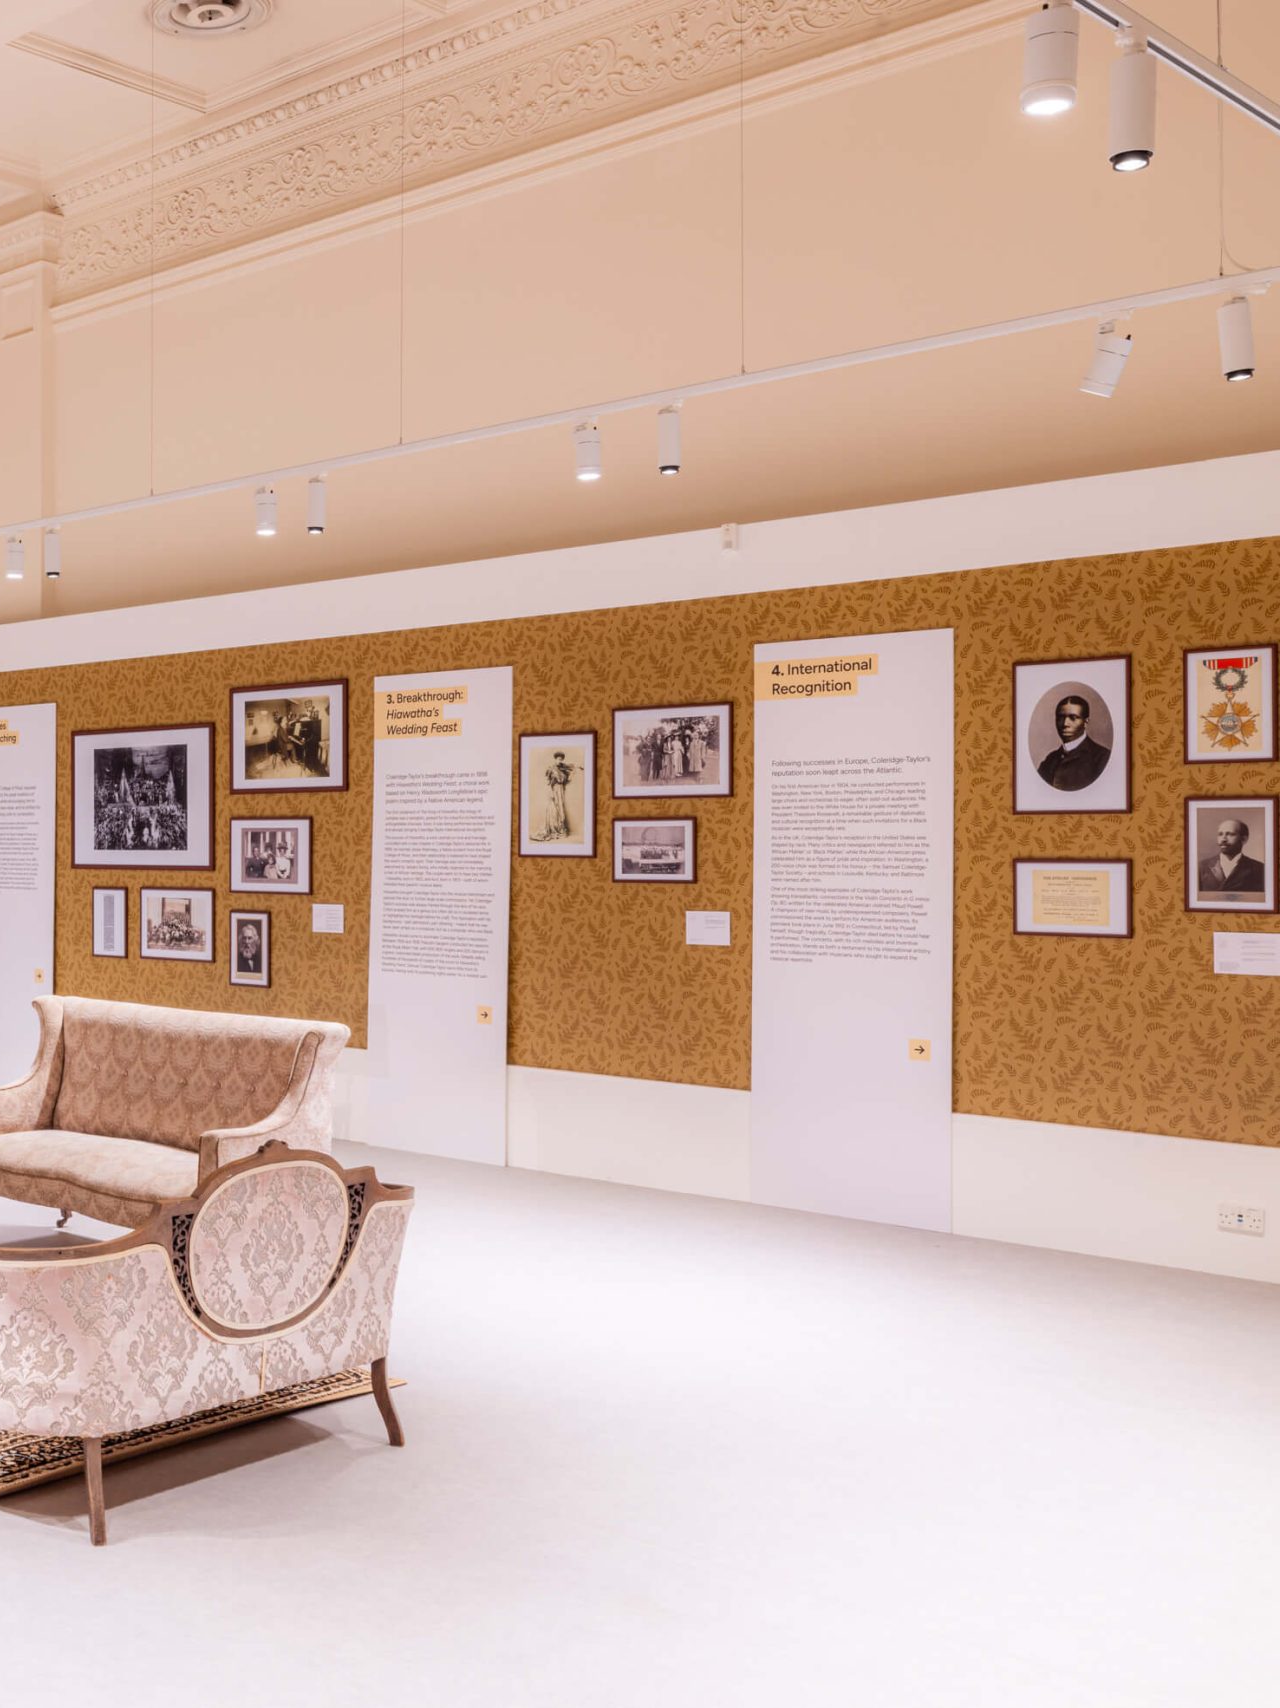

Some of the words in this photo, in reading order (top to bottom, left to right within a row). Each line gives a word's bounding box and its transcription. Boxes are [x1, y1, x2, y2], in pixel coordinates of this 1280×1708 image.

[771, 665, 784, 676] 4.
[788, 658, 872, 675] International
[772, 680, 851, 696] Recognition
[387, 694, 395, 704] 3.
[397, 690, 463, 704] Breakthrough:
[386, 707, 439, 720] Hiawatha's
[387, 724, 428, 736] Wedding
[431, 722, 457, 733] Feast
